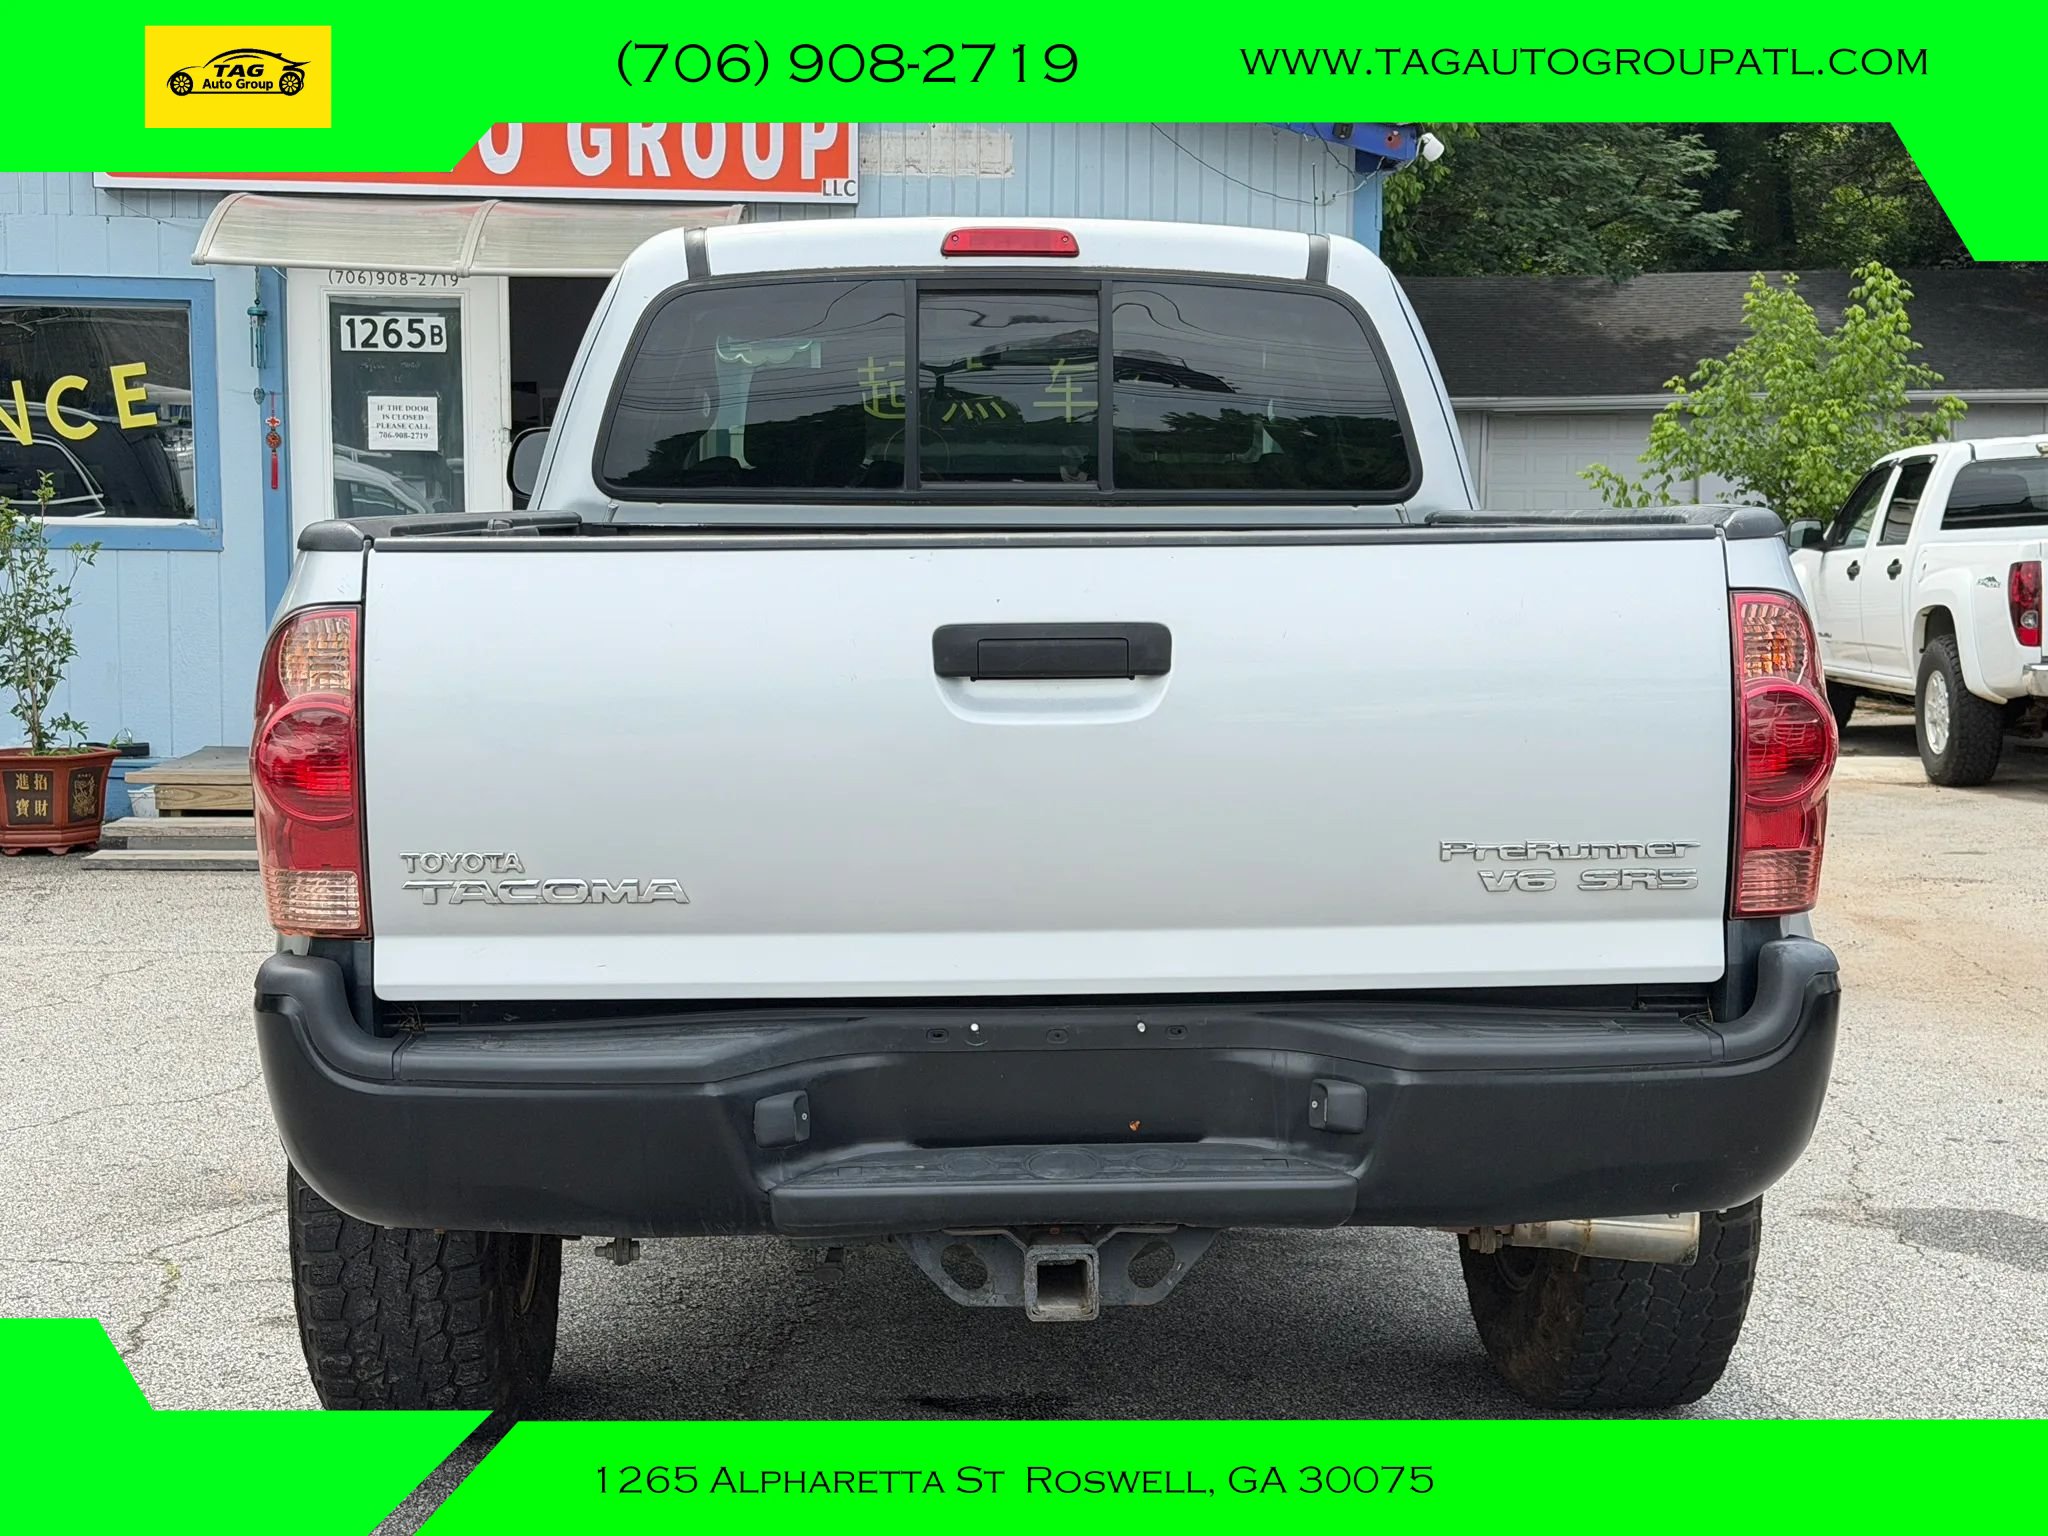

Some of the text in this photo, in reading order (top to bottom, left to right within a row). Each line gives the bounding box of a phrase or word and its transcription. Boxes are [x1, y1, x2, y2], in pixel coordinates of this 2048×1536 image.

[566, 123, 838, 180] GROUP
[822, 179, 857, 197] LLC
[328, 270, 460, 287] (706)908-2719
[376, 404, 430, 413] IF THE DOOR
[391, 413, 425, 421] CLOSED
[378, 431, 429, 440] 706-908-2719
[1439, 840, 1700, 861] PreRunner
[400, 852, 525, 873] TOYOTA
[1478, 867, 1699, 892] V6 SR5
[402, 879, 690, 905] TACOMA
